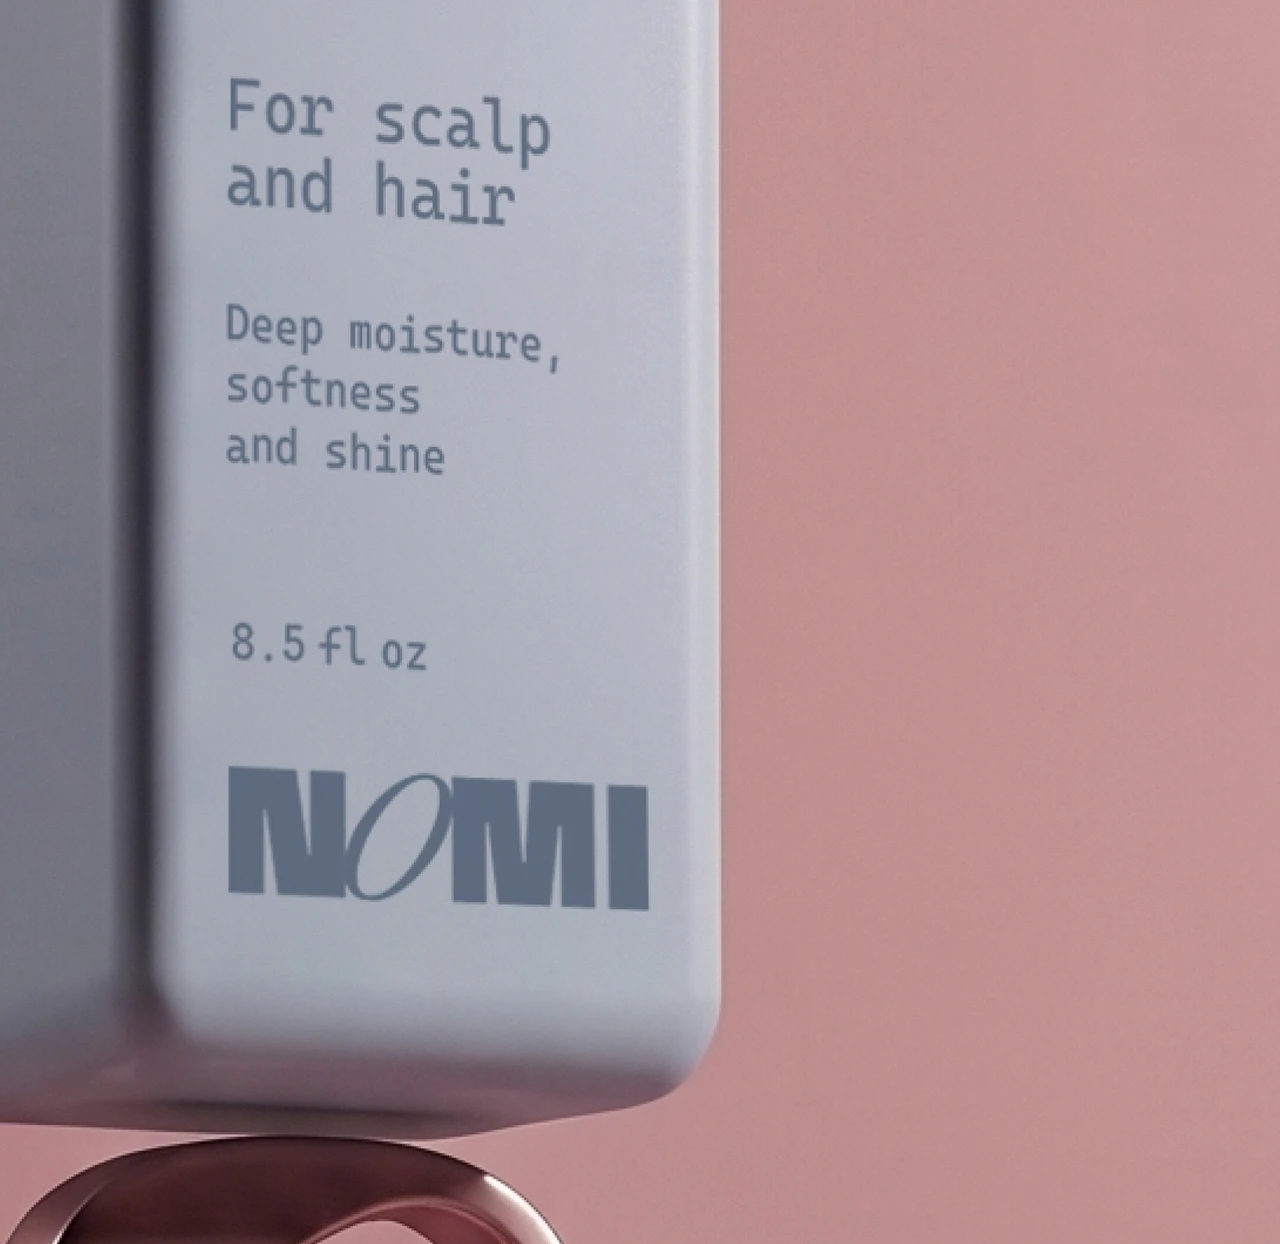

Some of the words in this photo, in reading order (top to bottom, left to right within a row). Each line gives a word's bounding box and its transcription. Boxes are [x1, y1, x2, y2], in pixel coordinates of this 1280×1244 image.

[229, 77, 334, 136] For
[375, 95, 551, 170] scalp
[227, 156, 333, 214] and
[375, 160, 516, 227] hair
[226, 303, 324, 356] Deep
[349, 314, 559, 375] moisture,
[227, 365, 421, 415] softness
[226, 427, 298, 466] and
[325, 432, 446, 476] shine
[231, 622, 306, 662] 8.5
[318, 625, 366, 666] fl
[381, 640, 428, 671] oz
[228, 765, 650, 912] NOMI
